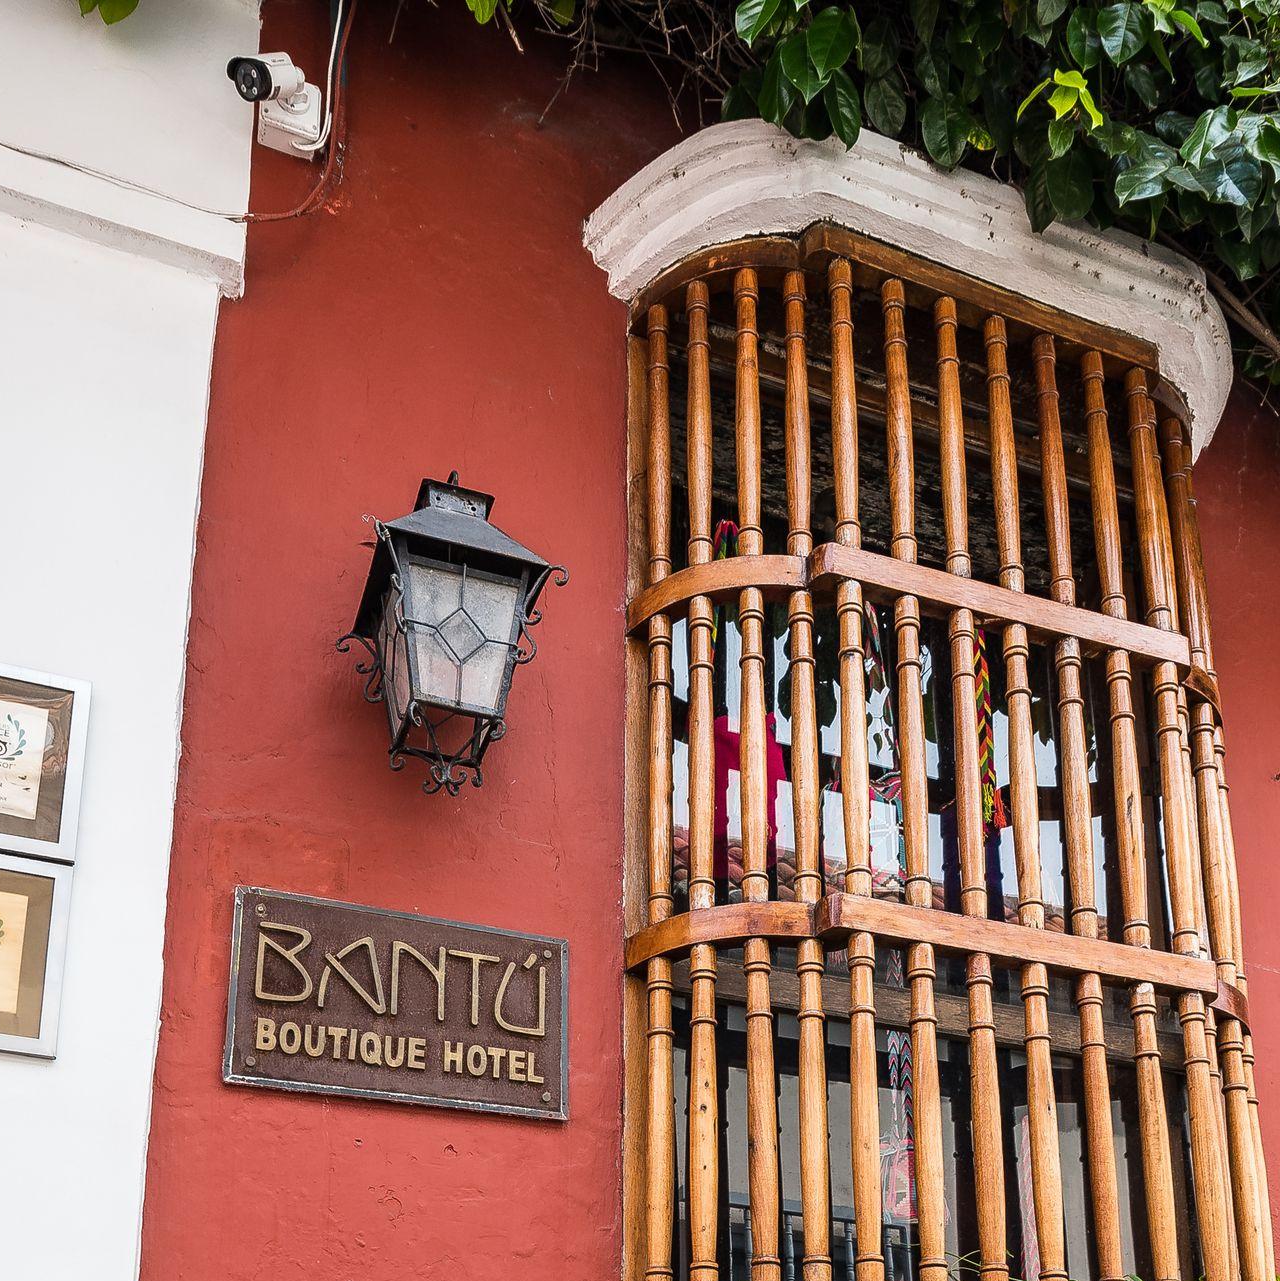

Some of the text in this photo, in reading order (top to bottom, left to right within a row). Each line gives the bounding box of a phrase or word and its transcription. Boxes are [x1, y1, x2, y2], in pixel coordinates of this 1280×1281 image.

[255, 921, 546, 1036] BANTÚ
[255, 1017, 545, 1083] BOUTIQUE HOTEL
